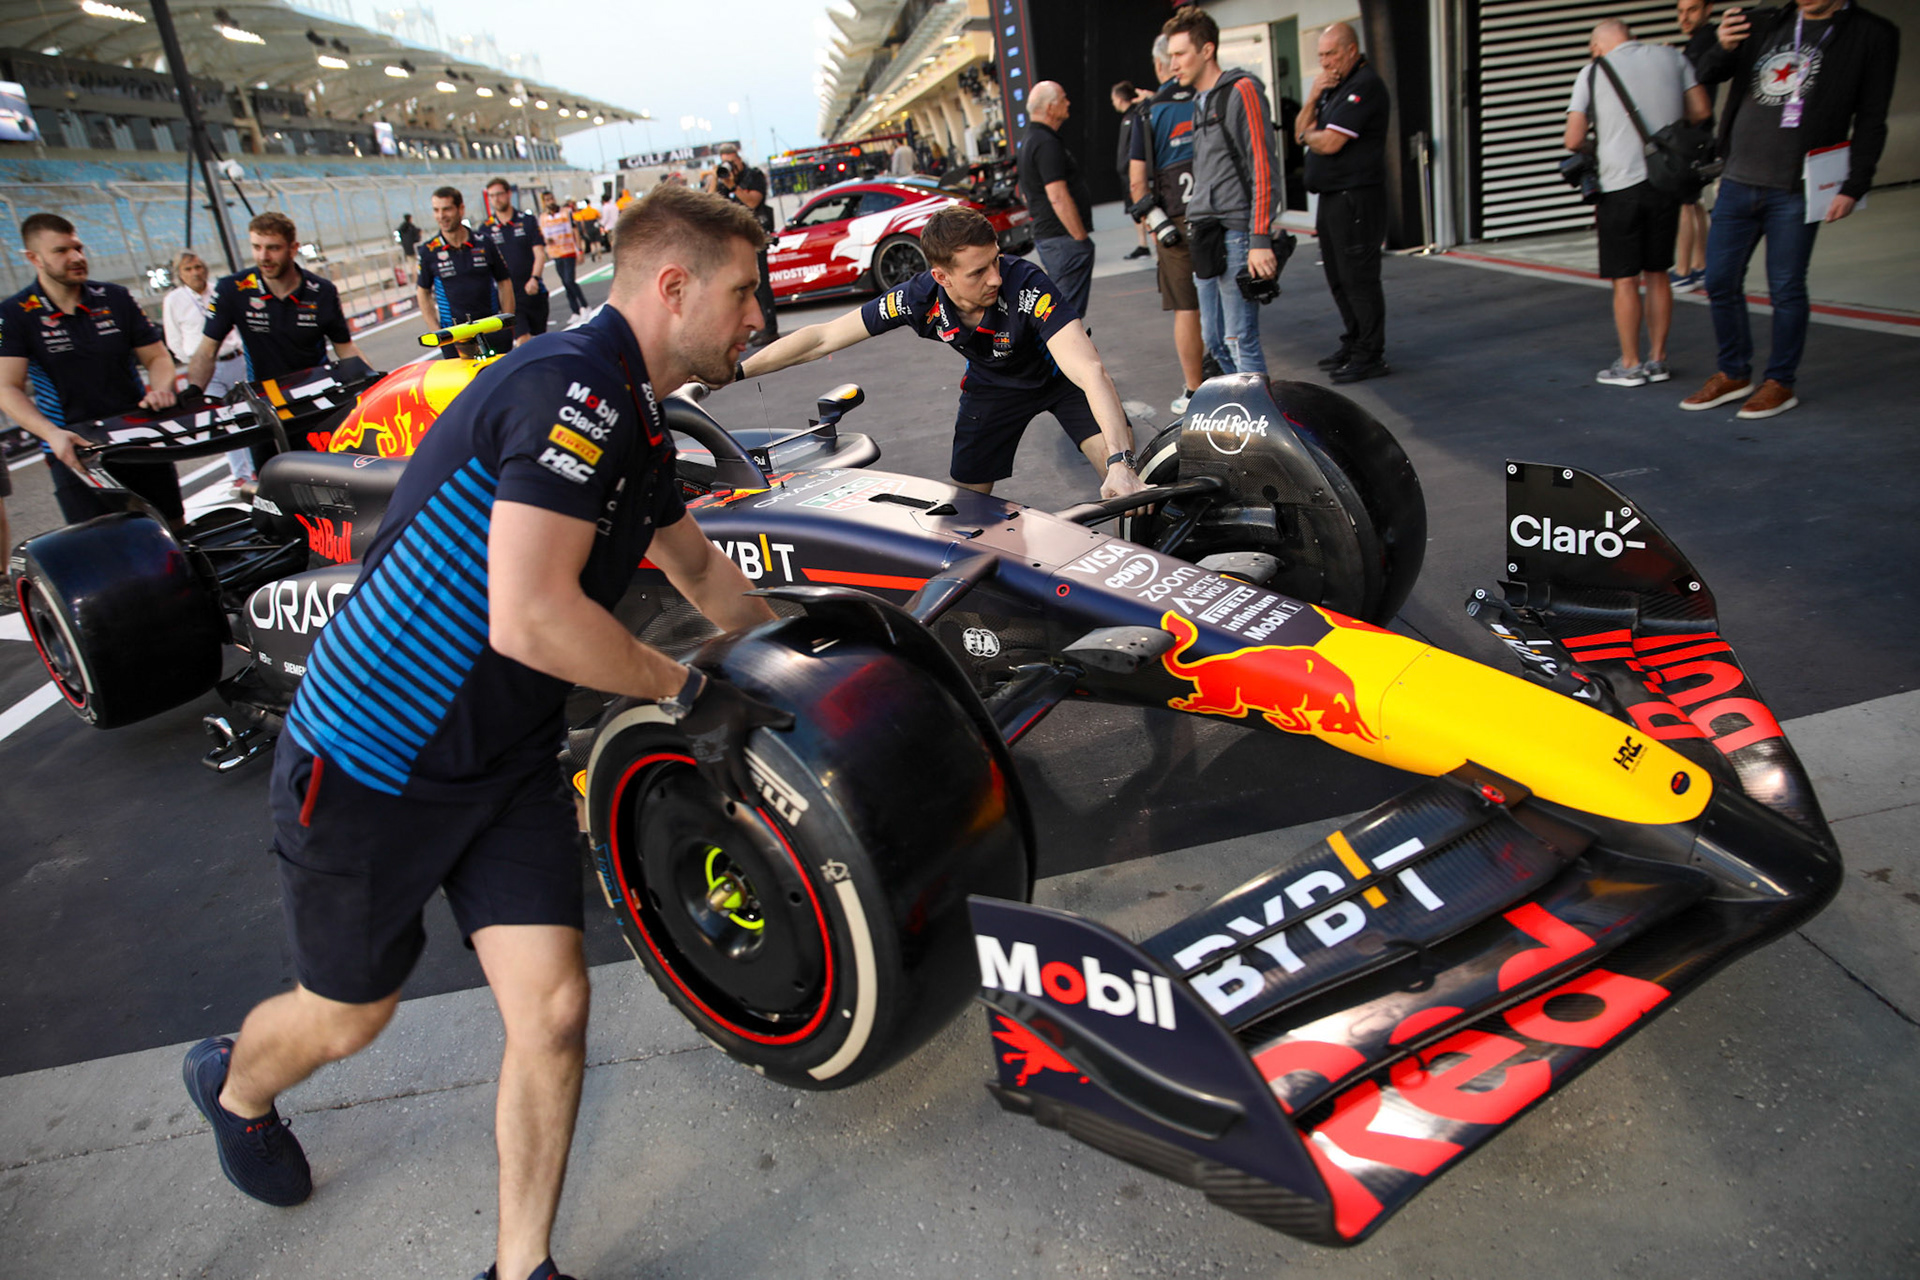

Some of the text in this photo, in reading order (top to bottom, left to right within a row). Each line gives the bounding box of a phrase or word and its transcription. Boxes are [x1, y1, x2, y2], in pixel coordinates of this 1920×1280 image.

[626, 147, 695, 169] GULF AIR
[895, 289, 907, 316] Claro
[939, 303, 950, 328] zoom
[566, 381, 619, 427] Mobil
[558, 405, 612, 442] Claro
[1189, 413, 1270, 437] Hard Rock
[538, 447, 597, 482] HRC
[806, 479, 876, 506] TAG
[1510, 511, 1646, 559] Claro
[711, 533, 795, 582] YBIT
[1065, 543, 1135, 575] VISA
[1104, 560, 1150, 589] CDW
[1137, 566, 1201, 602] zoom
[1182, 574, 1220, 598] ARCTIC
[1200, 580, 1230, 600] WOLF
[250, 580, 357, 634] ORAC
[1196, 585, 1258, 624] PIRELLI
[1221, 594, 1279, 631] infinitum
[1242, 609, 1292, 641] Mobil
[963, 629, 1000, 657] FIA
[1613, 735, 1643, 771] HRC
[1172, 830, 1445, 1016] BYBIT
[975, 935, 1177, 1031] Mobil
